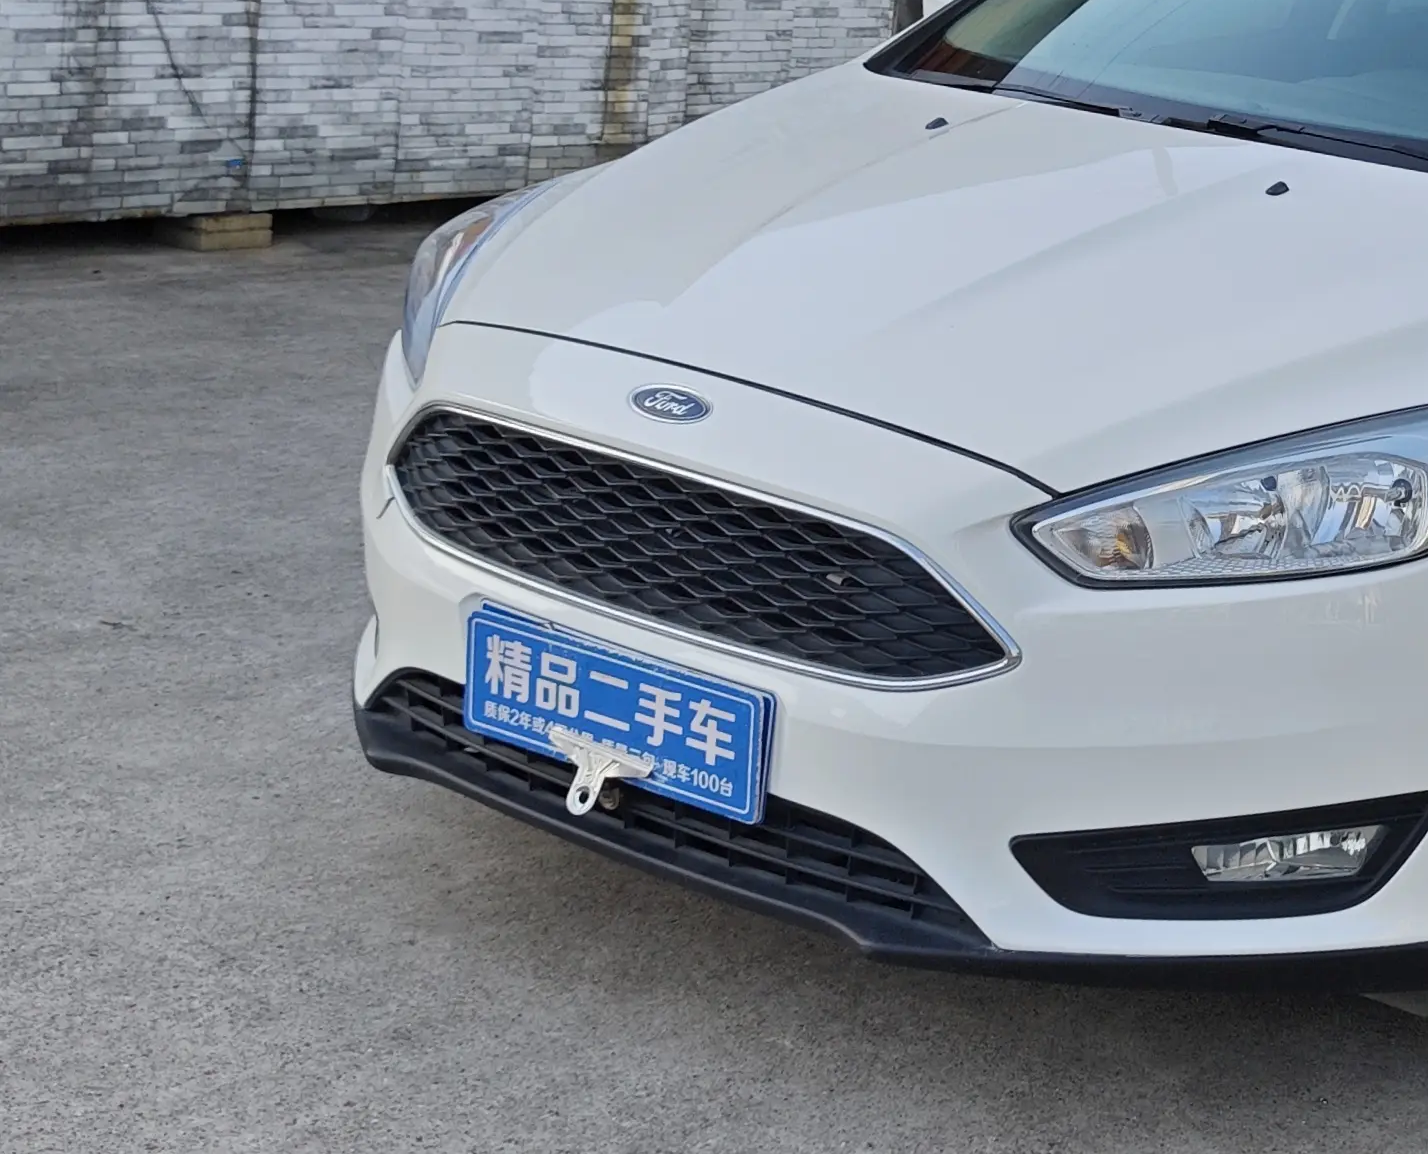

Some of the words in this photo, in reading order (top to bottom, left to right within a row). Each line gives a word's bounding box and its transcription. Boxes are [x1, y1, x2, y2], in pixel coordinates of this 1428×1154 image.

[485, 633, 736, 766] 精品二手车
[662, 758, 733, 798] 现车100台
